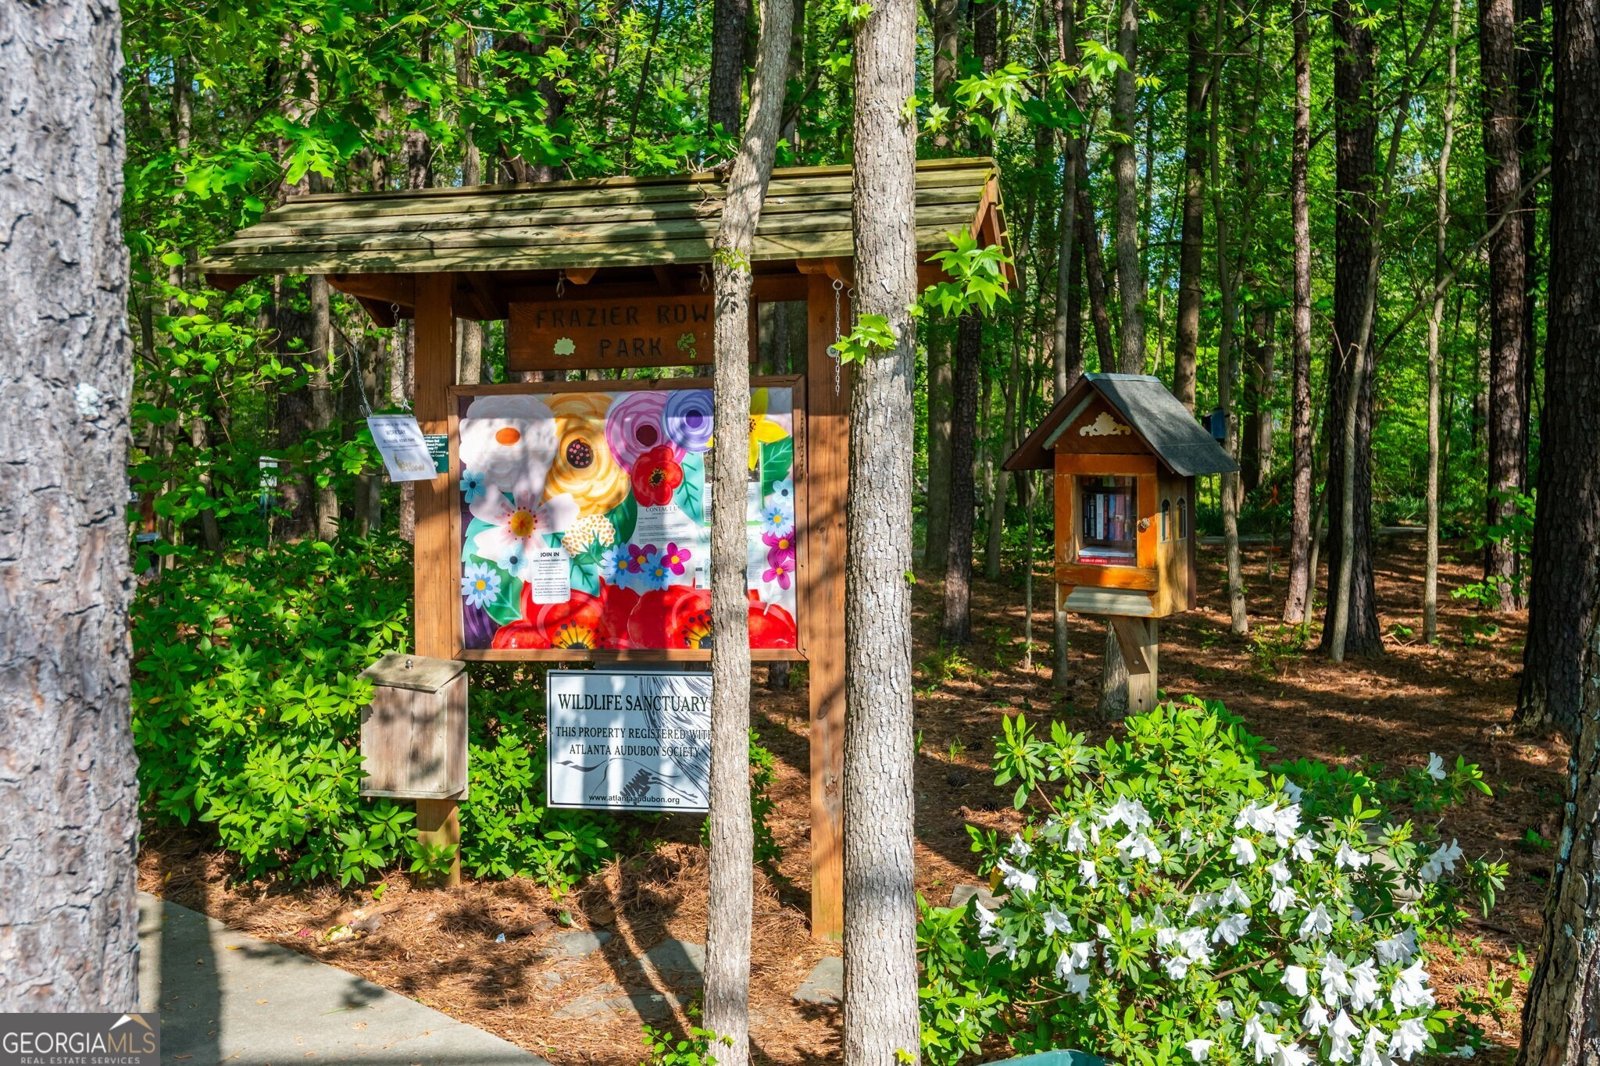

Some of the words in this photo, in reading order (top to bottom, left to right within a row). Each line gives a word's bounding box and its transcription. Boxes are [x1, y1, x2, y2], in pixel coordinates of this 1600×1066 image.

[535, 305, 640, 329] FRAZIER
[599, 337, 663, 359] PARK
[558, 693, 622, 711] WILDLIFE
[625, 694, 709, 712] SANCTUARY
[556, 726, 576, 737] THIS
[578, 726, 626, 739] PROPERTY
[628, 728, 686, 740] REGISTERED
[569, 744, 611, 755] ATLANTA
[614, 745, 659, 757] AUDUBON
[661, 746, 701, 758] SOCIETY
